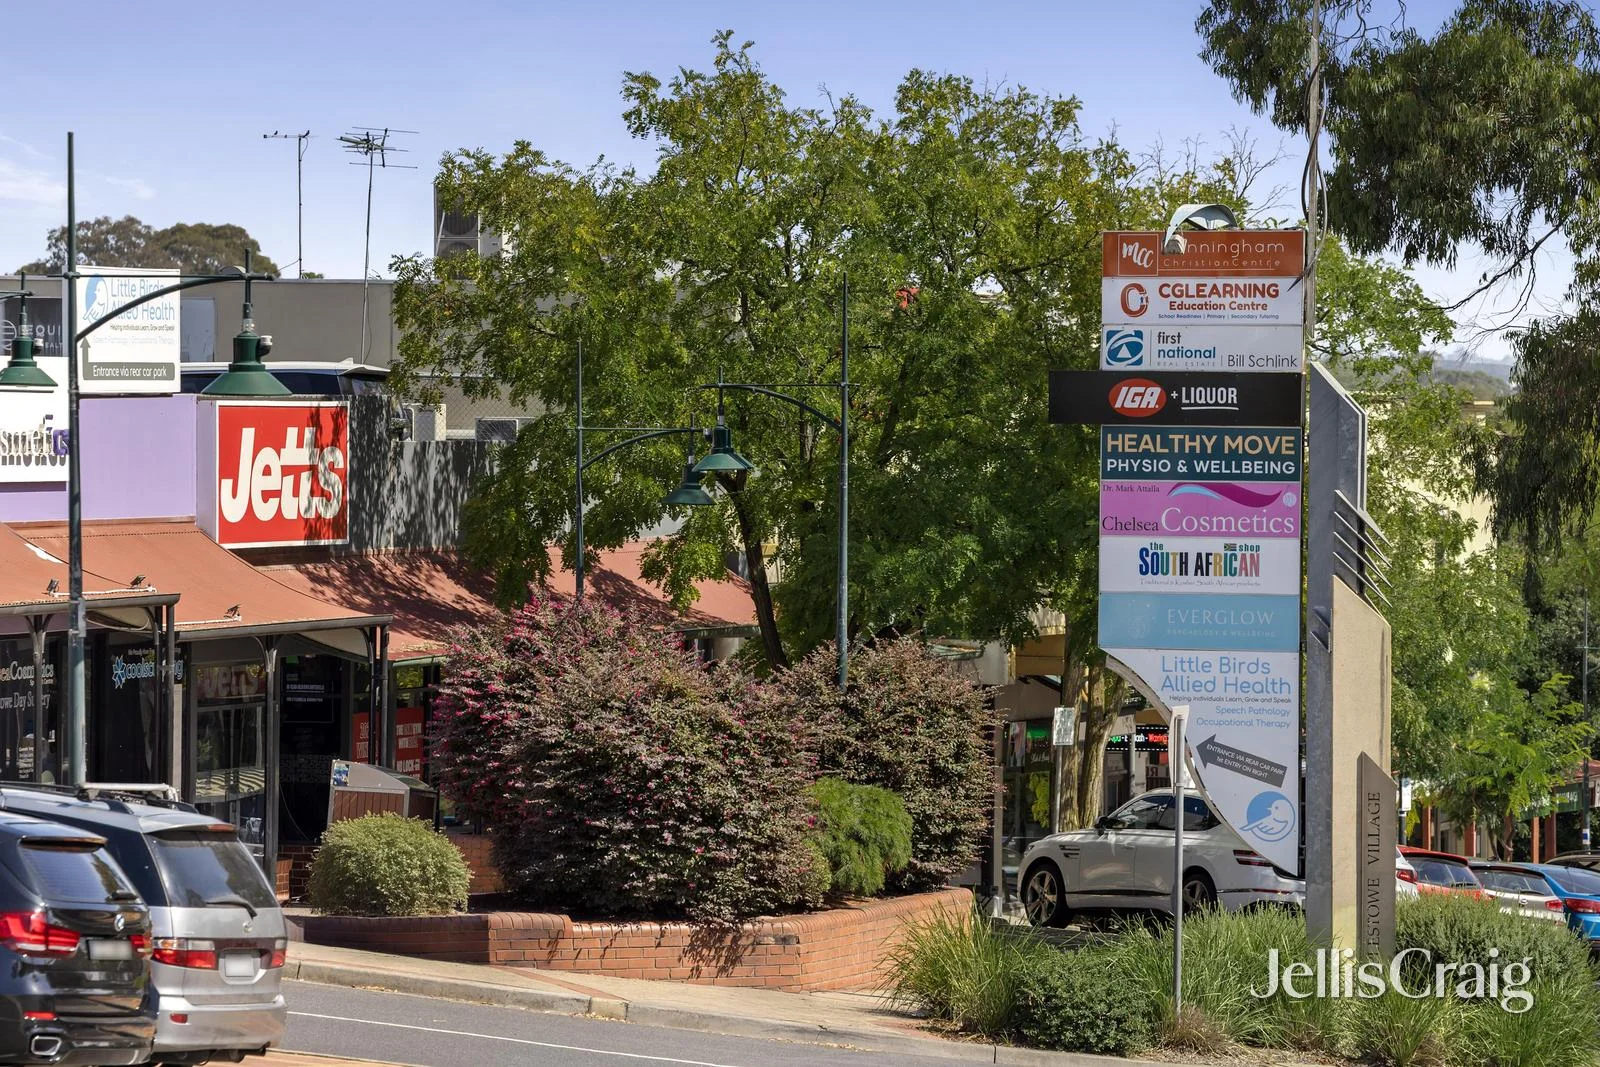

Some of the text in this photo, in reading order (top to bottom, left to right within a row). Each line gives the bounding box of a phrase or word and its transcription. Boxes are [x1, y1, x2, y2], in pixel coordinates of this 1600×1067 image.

[110, 278, 137, 297] Little
[1158, 283, 1280, 299] CGLEARNING
[141, 301, 175, 321] Health
[1169, 301, 1268, 312] Education Centre
[1157, 331, 1182, 344] first
[1157, 346, 1216, 359] national
[1227, 355, 1297, 368] Bill Schlink
[93, 365, 167, 378] Entrance via rear car park
[1114, 386, 1161, 409] IGA
[1182, 387, 1238, 404] LIQUOR
[1107, 434, 1296, 455] HEALTHY MOVE
[220, 426, 345, 524] Jetts
[1107, 459, 1295, 474] PHYSIO & WELLBEING
[1102, 484, 1114, 492] Dr.
[1136, 485, 1160, 493] Attalla
[1102, 507, 1295, 534] Chelsea Cosmetics
[1150, 542, 1260, 553] the shop
[1139, 547, 1260, 577] SOUTH AFRICAN
[1167, 608, 1274, 625] EVERGLOW
[1162, 656, 1271, 674] Little Birds
[1161, 675, 1292, 695] Allied Health
[1215, 706, 1290, 717] Speech Pathology
[1196, 717, 1290, 729] Occupational Therapy
[1206, 743, 1285, 775] ENTRANCE VIA REAR CAR PARK
[1224, 758, 1242, 768] ENTRY
[1242, 765, 1252, 773] ON
[1251, 767, 1268, 779] RIGHT
[1368, 792, 1380, 866] VILLAGE
